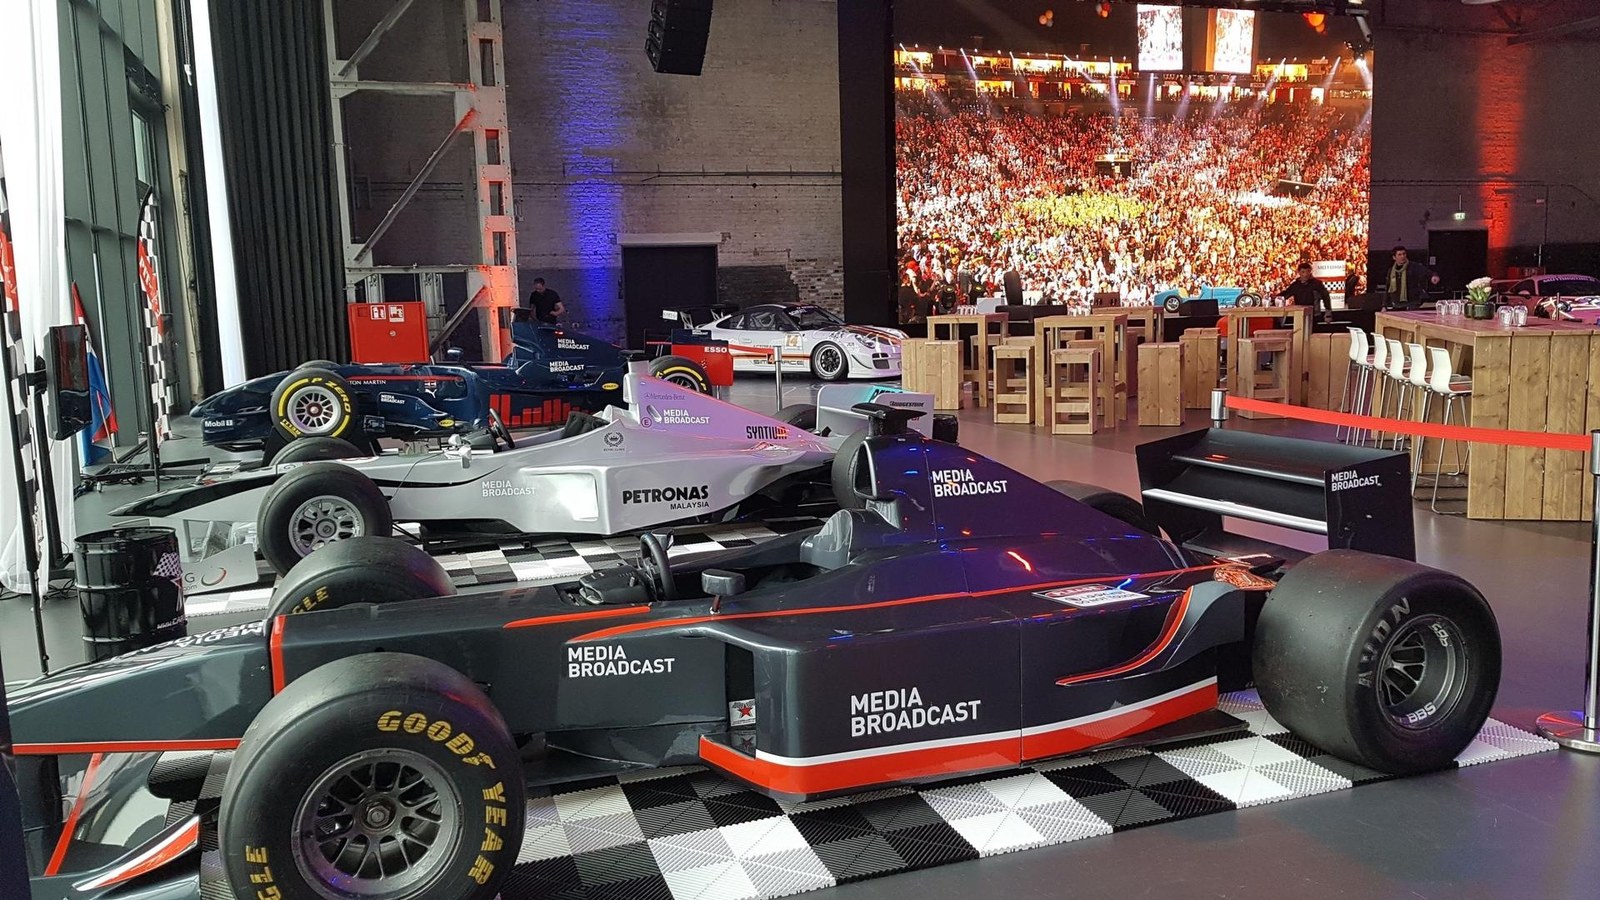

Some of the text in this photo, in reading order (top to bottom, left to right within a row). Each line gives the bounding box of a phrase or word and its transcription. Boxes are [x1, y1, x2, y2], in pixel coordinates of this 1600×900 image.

[549, 364, 585, 373] BROADCAST
[325, 381, 351, 412] ZERO
[663, 409, 689, 417] MEDIA
[664, 416, 710, 424] BROADCAST
[481, 480, 511, 488] MEDIA
[931, 468, 975, 484] MEDIA
[1331, 470, 1358, 482] MEDIA
[1331, 475, 1380, 491] BROADCAST
[482, 486, 536, 497] BROADCAST
[622, 484, 709, 505] PETRONAS
[933, 480, 1008, 498] BROADCAST
[670, 501, 710, 510] MALAYSIA
[567, 644, 627, 662] MEDIA
[568, 657, 676, 678] BROADCAST
[850, 686, 924, 716] MEDIA
[851, 699, 982, 738] BROADCAST
[1406, 702, 1437, 723] BBS
